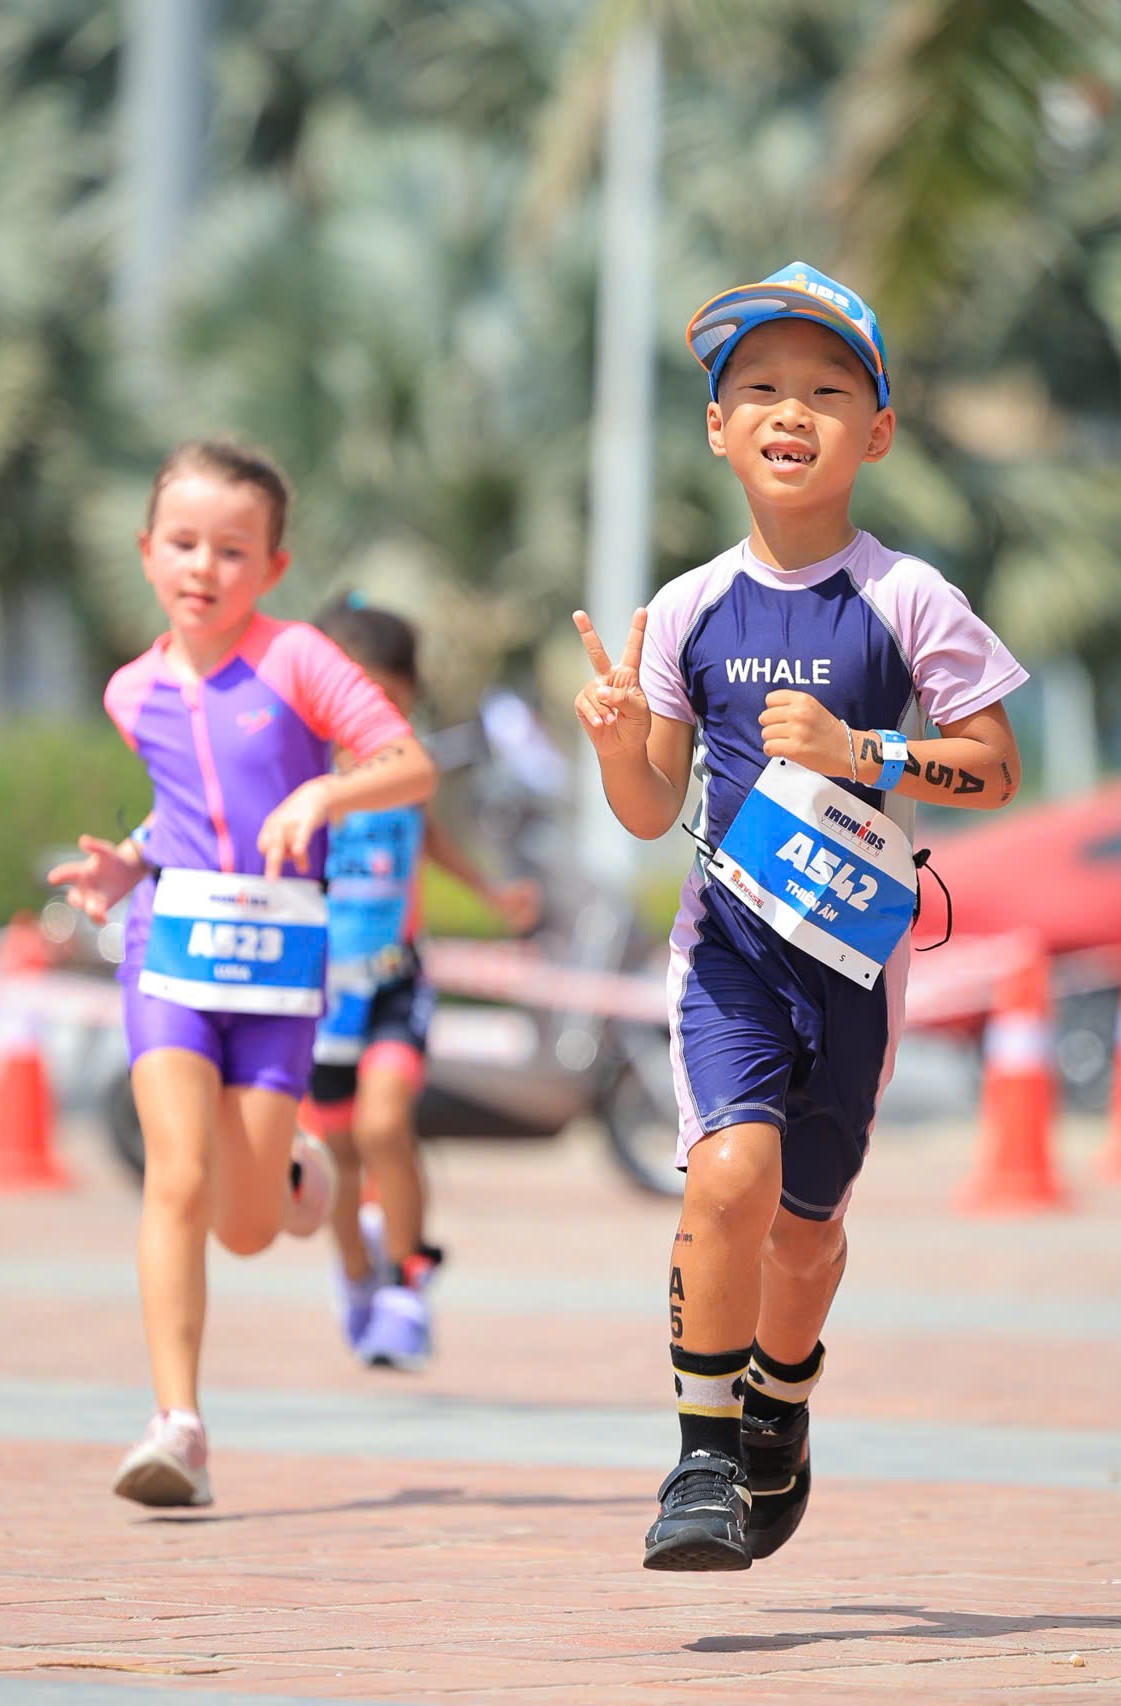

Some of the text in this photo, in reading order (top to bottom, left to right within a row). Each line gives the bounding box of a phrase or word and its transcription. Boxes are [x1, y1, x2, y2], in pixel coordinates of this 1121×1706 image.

[725, 658, 831, 684] WHALE
[824, 805, 886, 851] IRONKIDS
[775, 831, 878, 912] A542
[785, 879, 839, 922] THIÊN ÂN
[187, 921, 284, 963] A523
[840, 954, 847, 962] S
